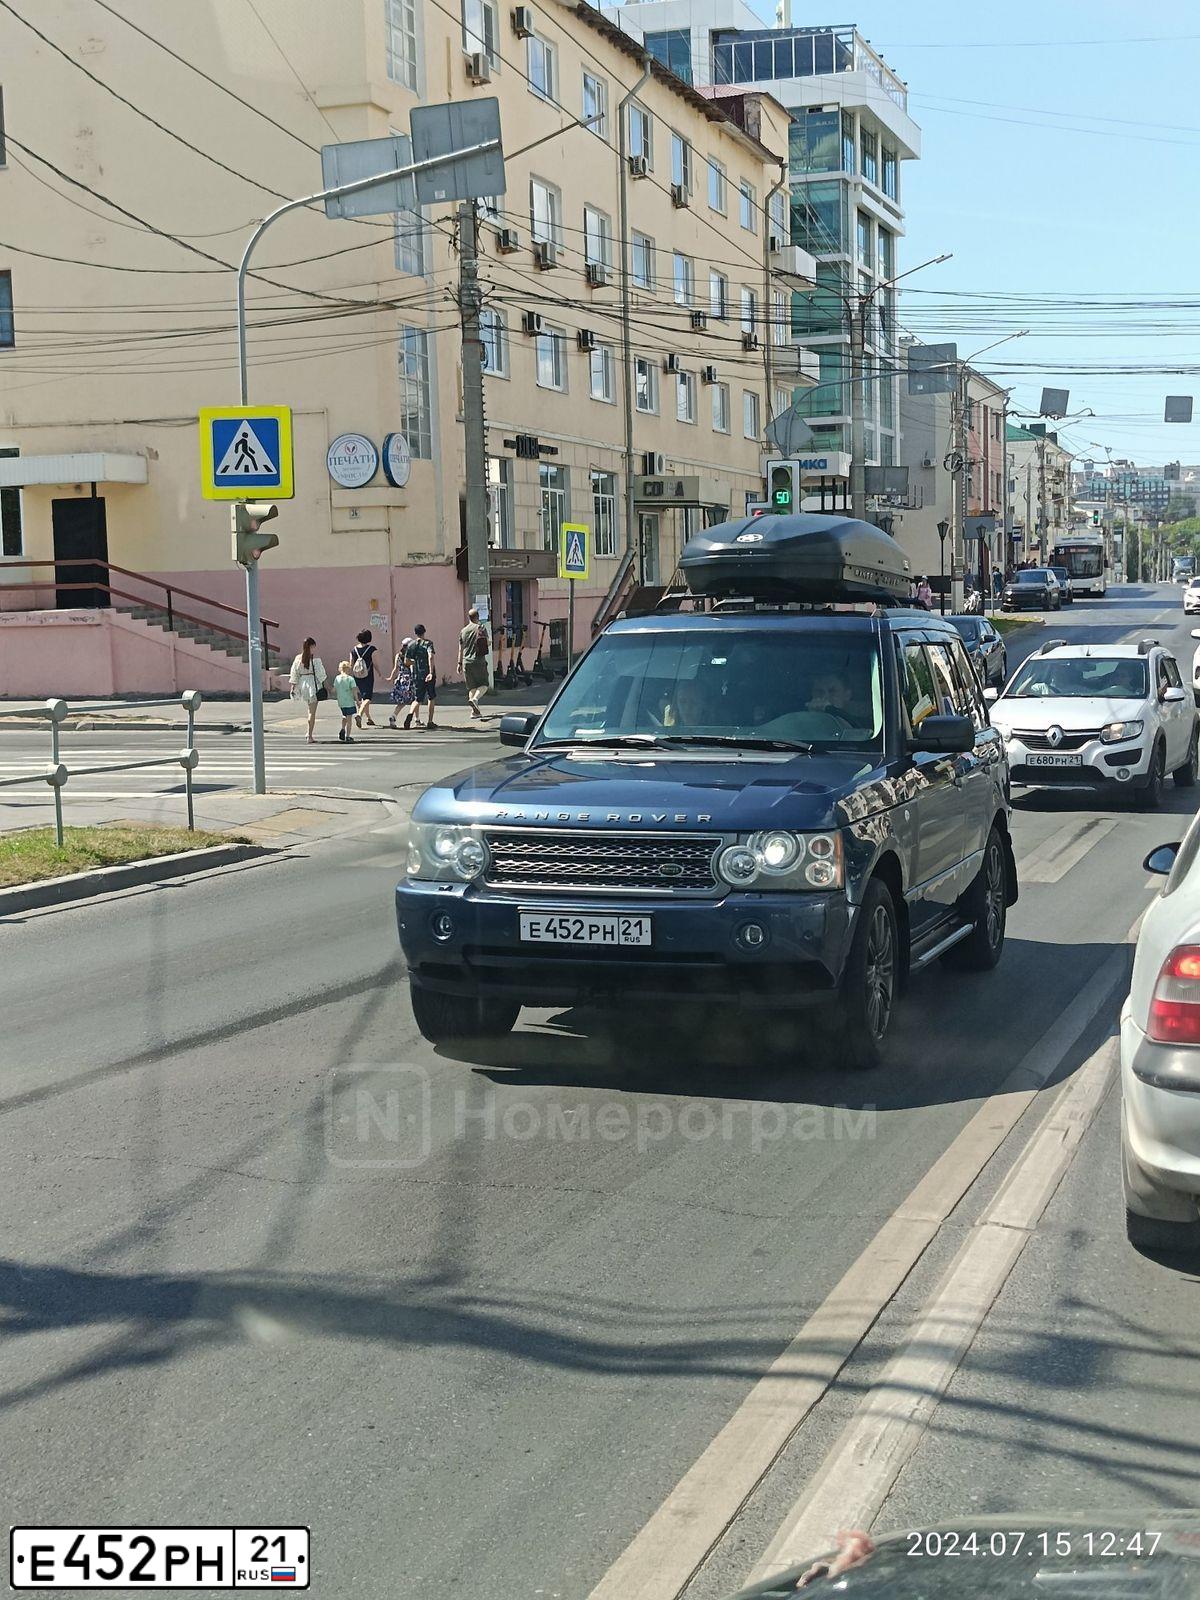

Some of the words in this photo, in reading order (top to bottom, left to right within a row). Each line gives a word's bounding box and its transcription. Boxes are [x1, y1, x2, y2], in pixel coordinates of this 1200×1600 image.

[329, 454, 375, 466] ПЕЧАТИ
[776, 491, 790, 504] 50
[495, 810, 590, 822] RANGE
[606, 812, 713, 824] ROVER
[529, 917, 615, 942] Е452РН
[621, 919, 643, 937] 21
